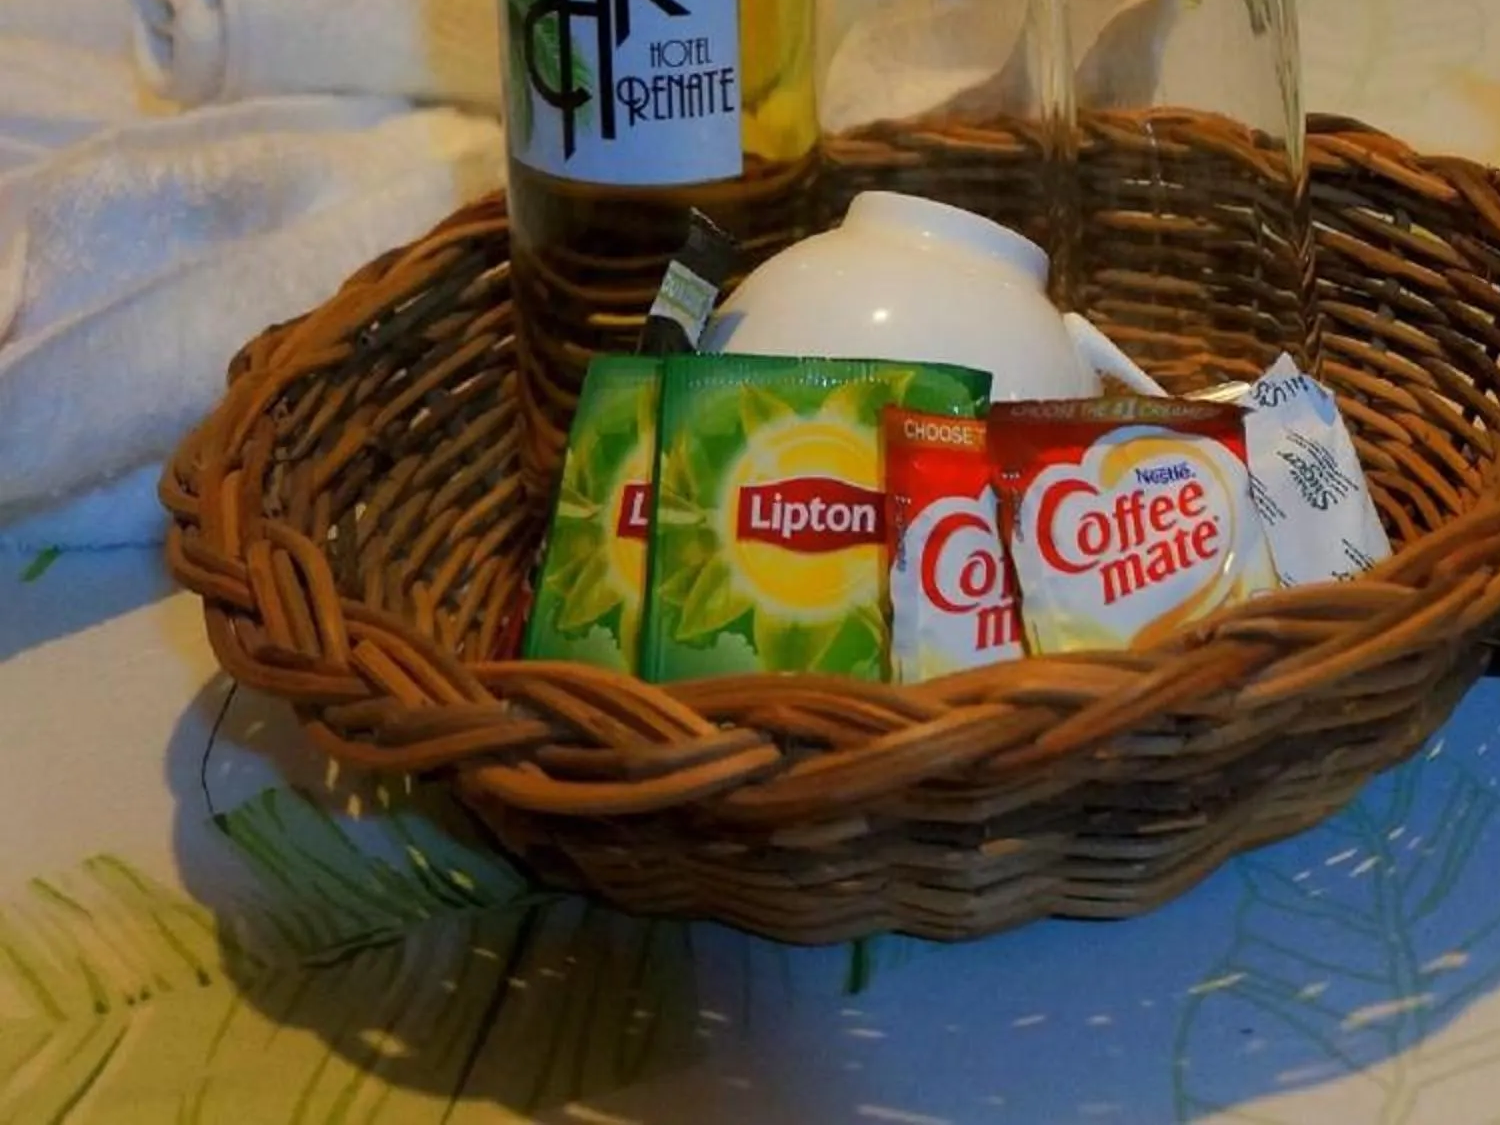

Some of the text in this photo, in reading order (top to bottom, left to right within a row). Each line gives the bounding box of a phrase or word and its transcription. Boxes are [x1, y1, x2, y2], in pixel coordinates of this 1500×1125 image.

[650, 38, 712, 68] HOTEL
[616, 67, 735, 127] RENATE
[904, 418, 974, 445] CHOOSE
[750, 493, 877, 538] Lipton
[1036, 478, 1206, 574] Coffee
[920, 512, 1013, 613] Co
[1099, 519, 1219, 606] mate
